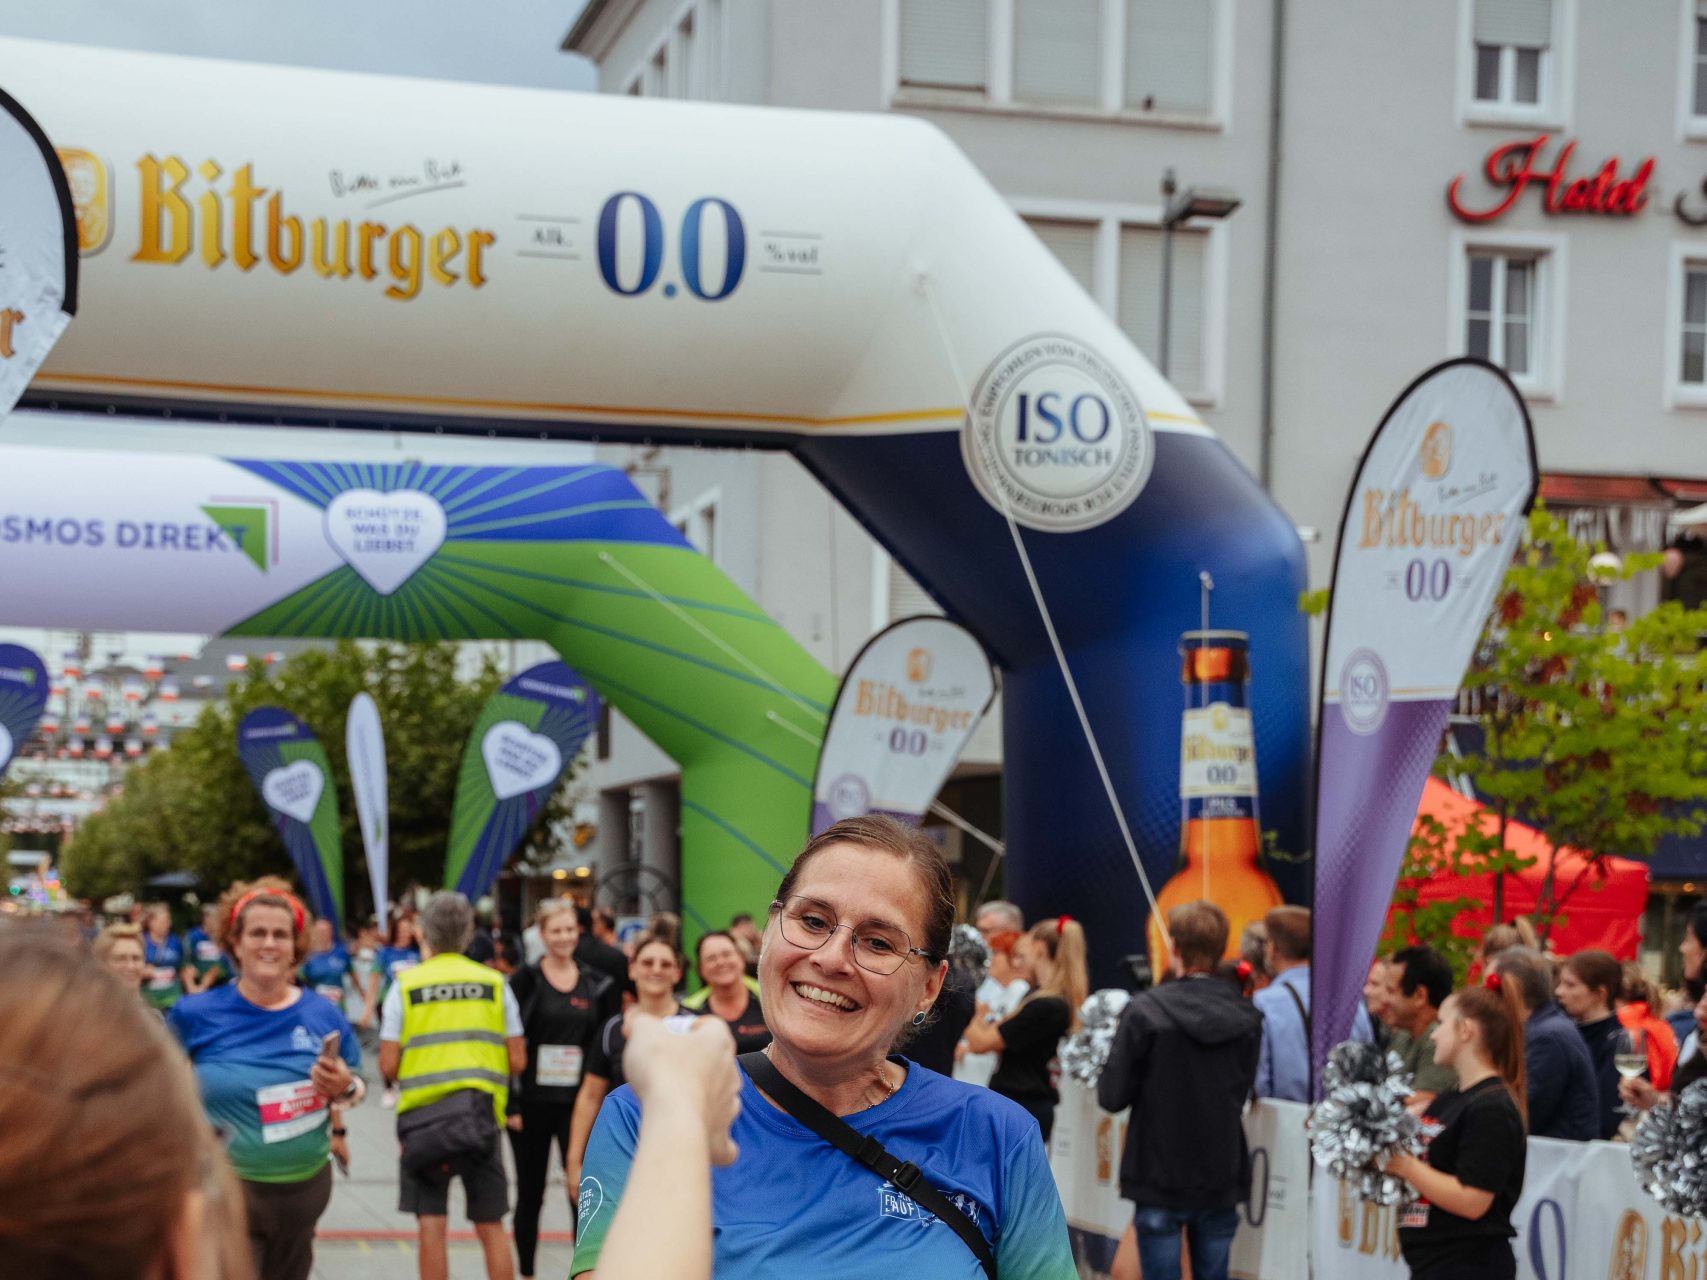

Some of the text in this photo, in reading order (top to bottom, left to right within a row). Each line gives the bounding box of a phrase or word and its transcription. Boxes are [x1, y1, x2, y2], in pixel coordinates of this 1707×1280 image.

[1448, 134, 1656, 222] Hotel
[129, 152, 496, 301] Bitburger
[597, 189, 747, 302] 0.0
[1014, 391, 1111, 444] ISO
[1011, 449, 1112, 467] TONISCH
[115, 519, 247, 551] DIREKT
[1356, 486, 1505, 557] Bitburger
[853, 675, 975, 735] Bitburger
[421, 983, 484, 1003] FOTO
